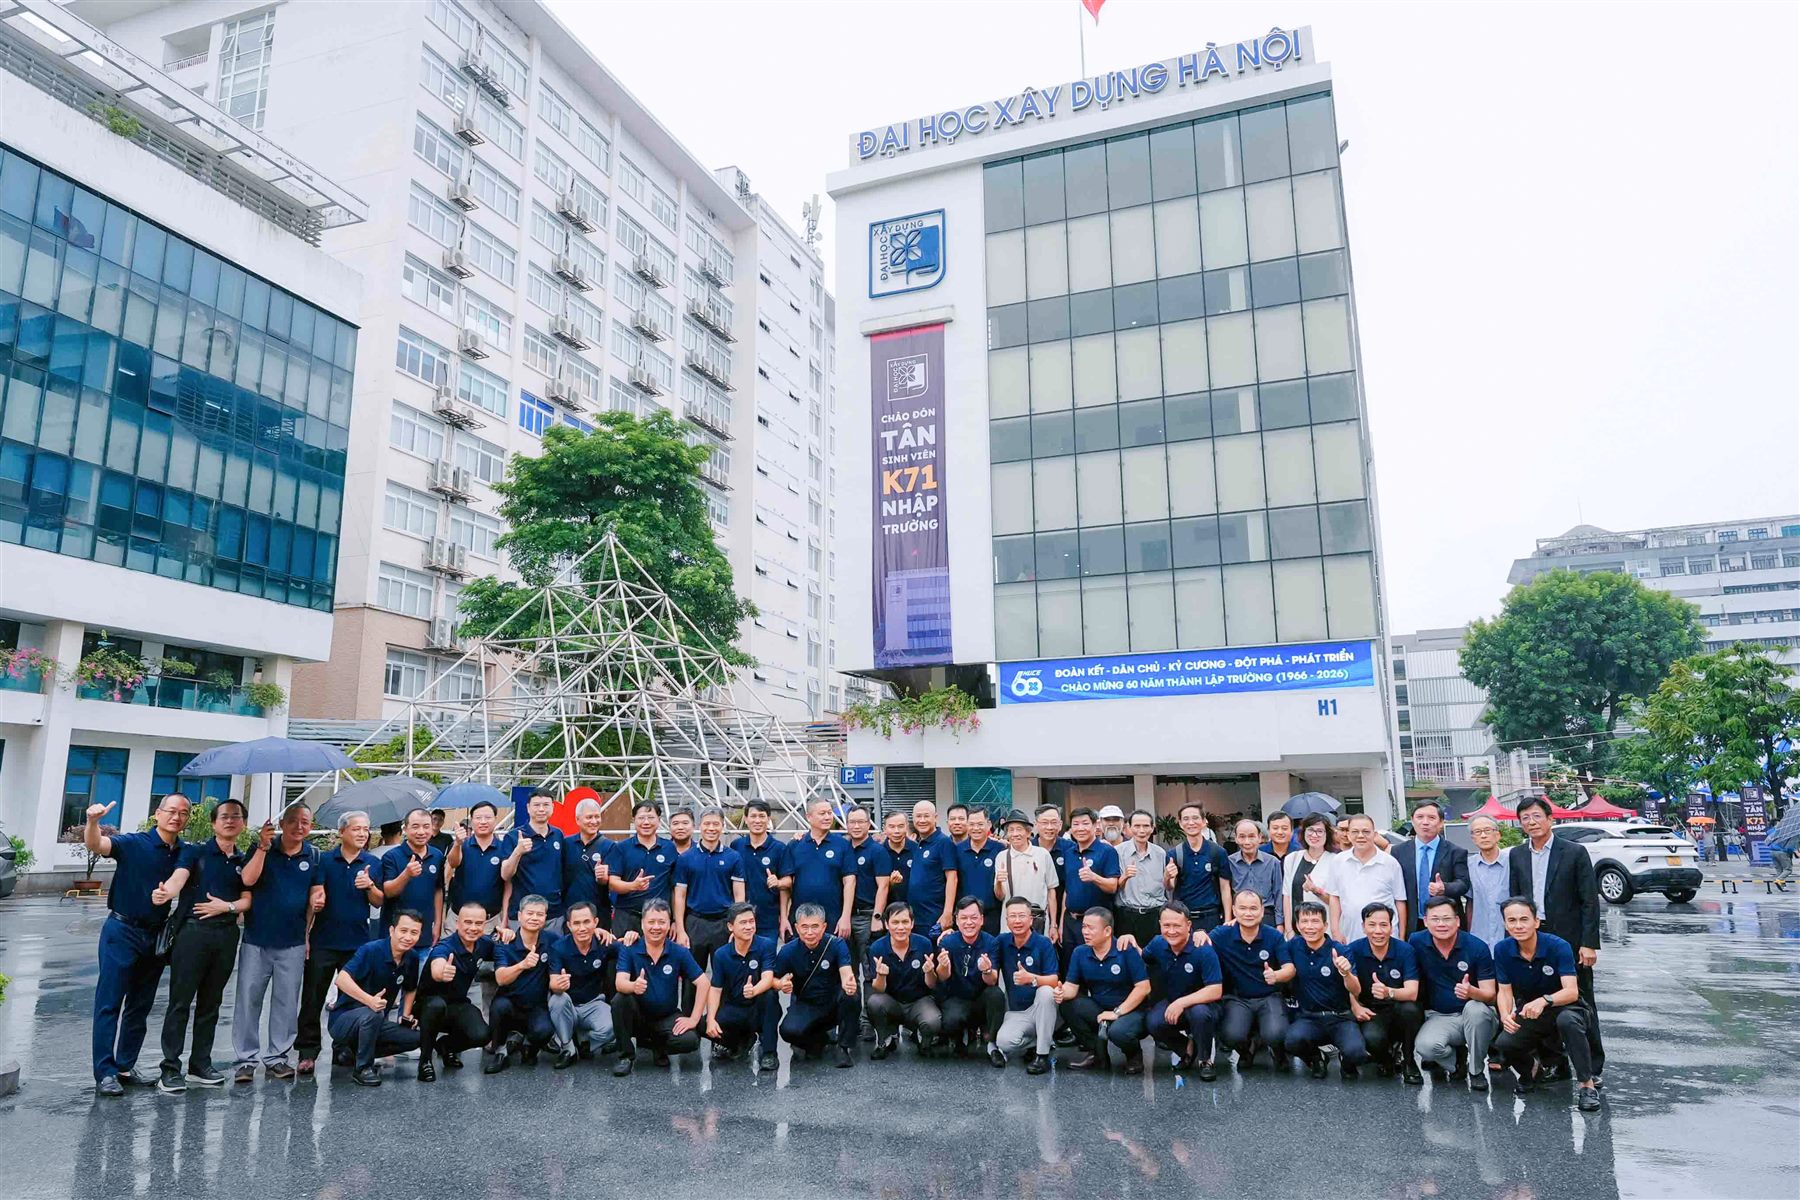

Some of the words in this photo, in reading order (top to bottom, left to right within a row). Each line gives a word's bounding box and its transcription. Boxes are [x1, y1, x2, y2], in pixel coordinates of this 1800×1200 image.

[857, 122, 910, 159] ĐẠI
[918, 105, 988, 145] HỌC
[993, 86, 1062, 129] XÂY
[1071, 62, 1168, 111] DỰNG
[1177, 42, 1229, 87] HÀ
[1236, 26, 1302, 72] NỘI
[873, 223, 894, 237] XÂY
[895, 219, 924, 233] DỰNG
[880, 236, 891, 261] HỌC
[880, 262, 891, 281] ĐẠI
[881, 412, 910, 423] CHÀO
[912, 407, 936, 419] ĐÓN
[881, 422, 936, 451] TÂN
[882, 454, 908, 465] SINH
[911, 449, 936, 461] VIÊN
[883, 464, 938, 496] K71
[882, 492, 938, 517] NHẬP
[882, 518, 938, 535] TRƯỜNG
[1055, 666, 1085, 678] ĐOÀN
[1088, 663, 1105, 676] KẾT
[1137, 660, 1160, 673] CHỦ
[1168, 659, 1182, 672] KỶ
[1184, 660, 1226, 671] CƯƠNG
[1234, 656, 1257, 669] ĐỘT
[1260, 654, 1283, 667] PHÁ
[1292, 652, 1321, 665] PHÁT
[1323, 648, 1354, 662] TRIỂN
[1061, 681, 1091, 692] CHÀO
[1093, 680, 1124, 691] MỪNG
[1126, 679, 1138, 689] 60
[1140, 676, 1164, 688] NĂM
[1166, 675, 1202, 688] THÀNH
[1205, 673, 1225, 687] LẬP
[1227, 671, 1273, 684] TRƯỜNG
[1276, 671, 1307, 685] (1966
[1316, 668, 1349, 680] 2026)
[1317, 699, 1338, 716] H1
[844, 769, 856, 782] P
